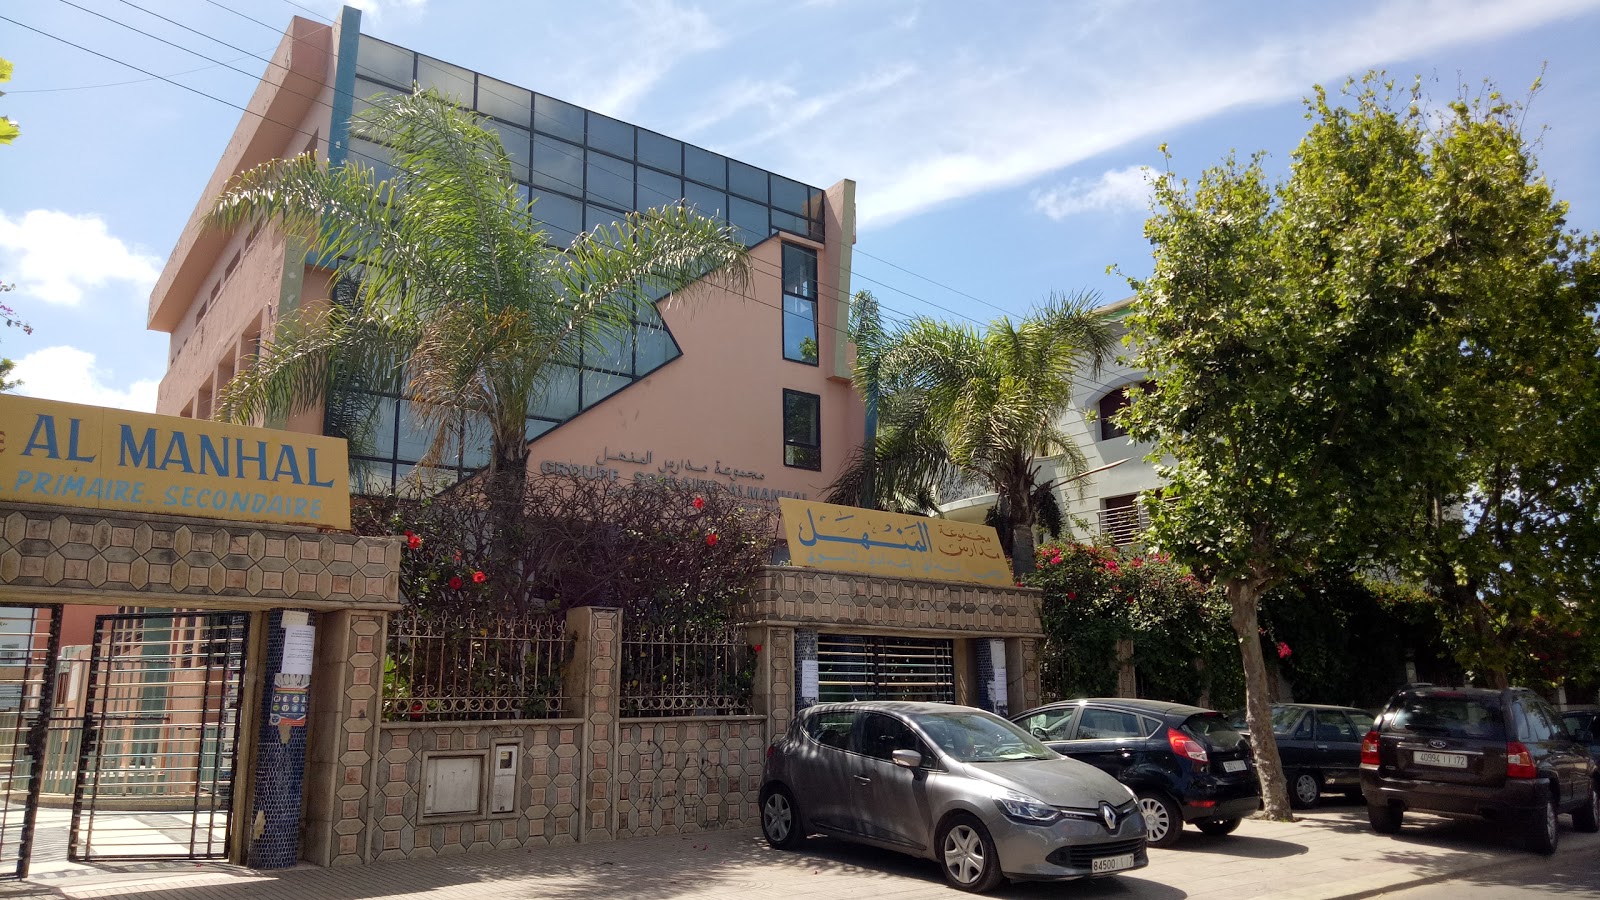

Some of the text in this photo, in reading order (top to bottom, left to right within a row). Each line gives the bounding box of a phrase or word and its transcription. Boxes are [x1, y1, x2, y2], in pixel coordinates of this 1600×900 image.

[19, 413, 335, 489] AL MANHAL
[163, 485, 322, 519] SECONDAIRE
